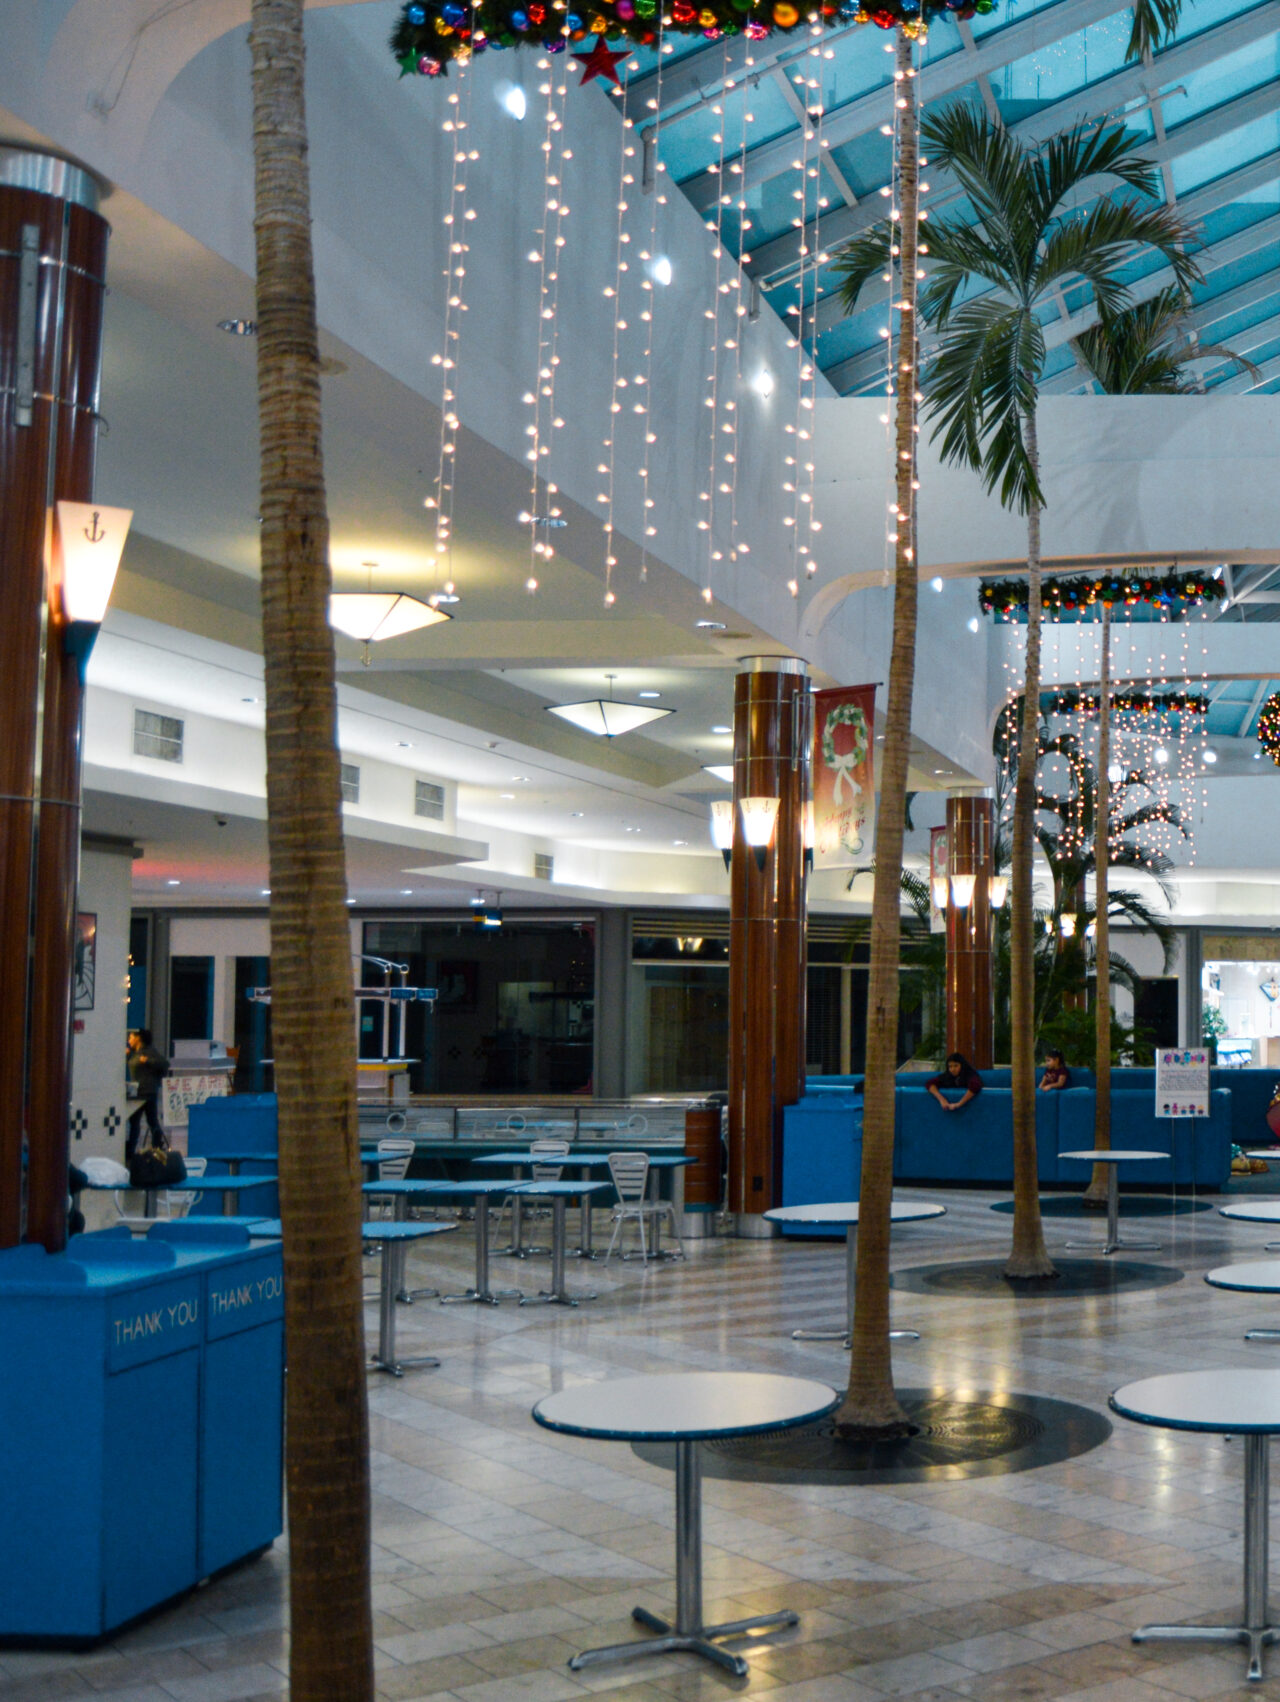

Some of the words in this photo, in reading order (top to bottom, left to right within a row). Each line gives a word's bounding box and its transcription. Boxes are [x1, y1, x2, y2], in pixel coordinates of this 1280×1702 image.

[211, 1283, 252, 1316] THANK
[256, 1275, 283, 1300] YOU
[114, 1309, 163, 1345] THANK
[167, 1299, 199, 1328] YOU
